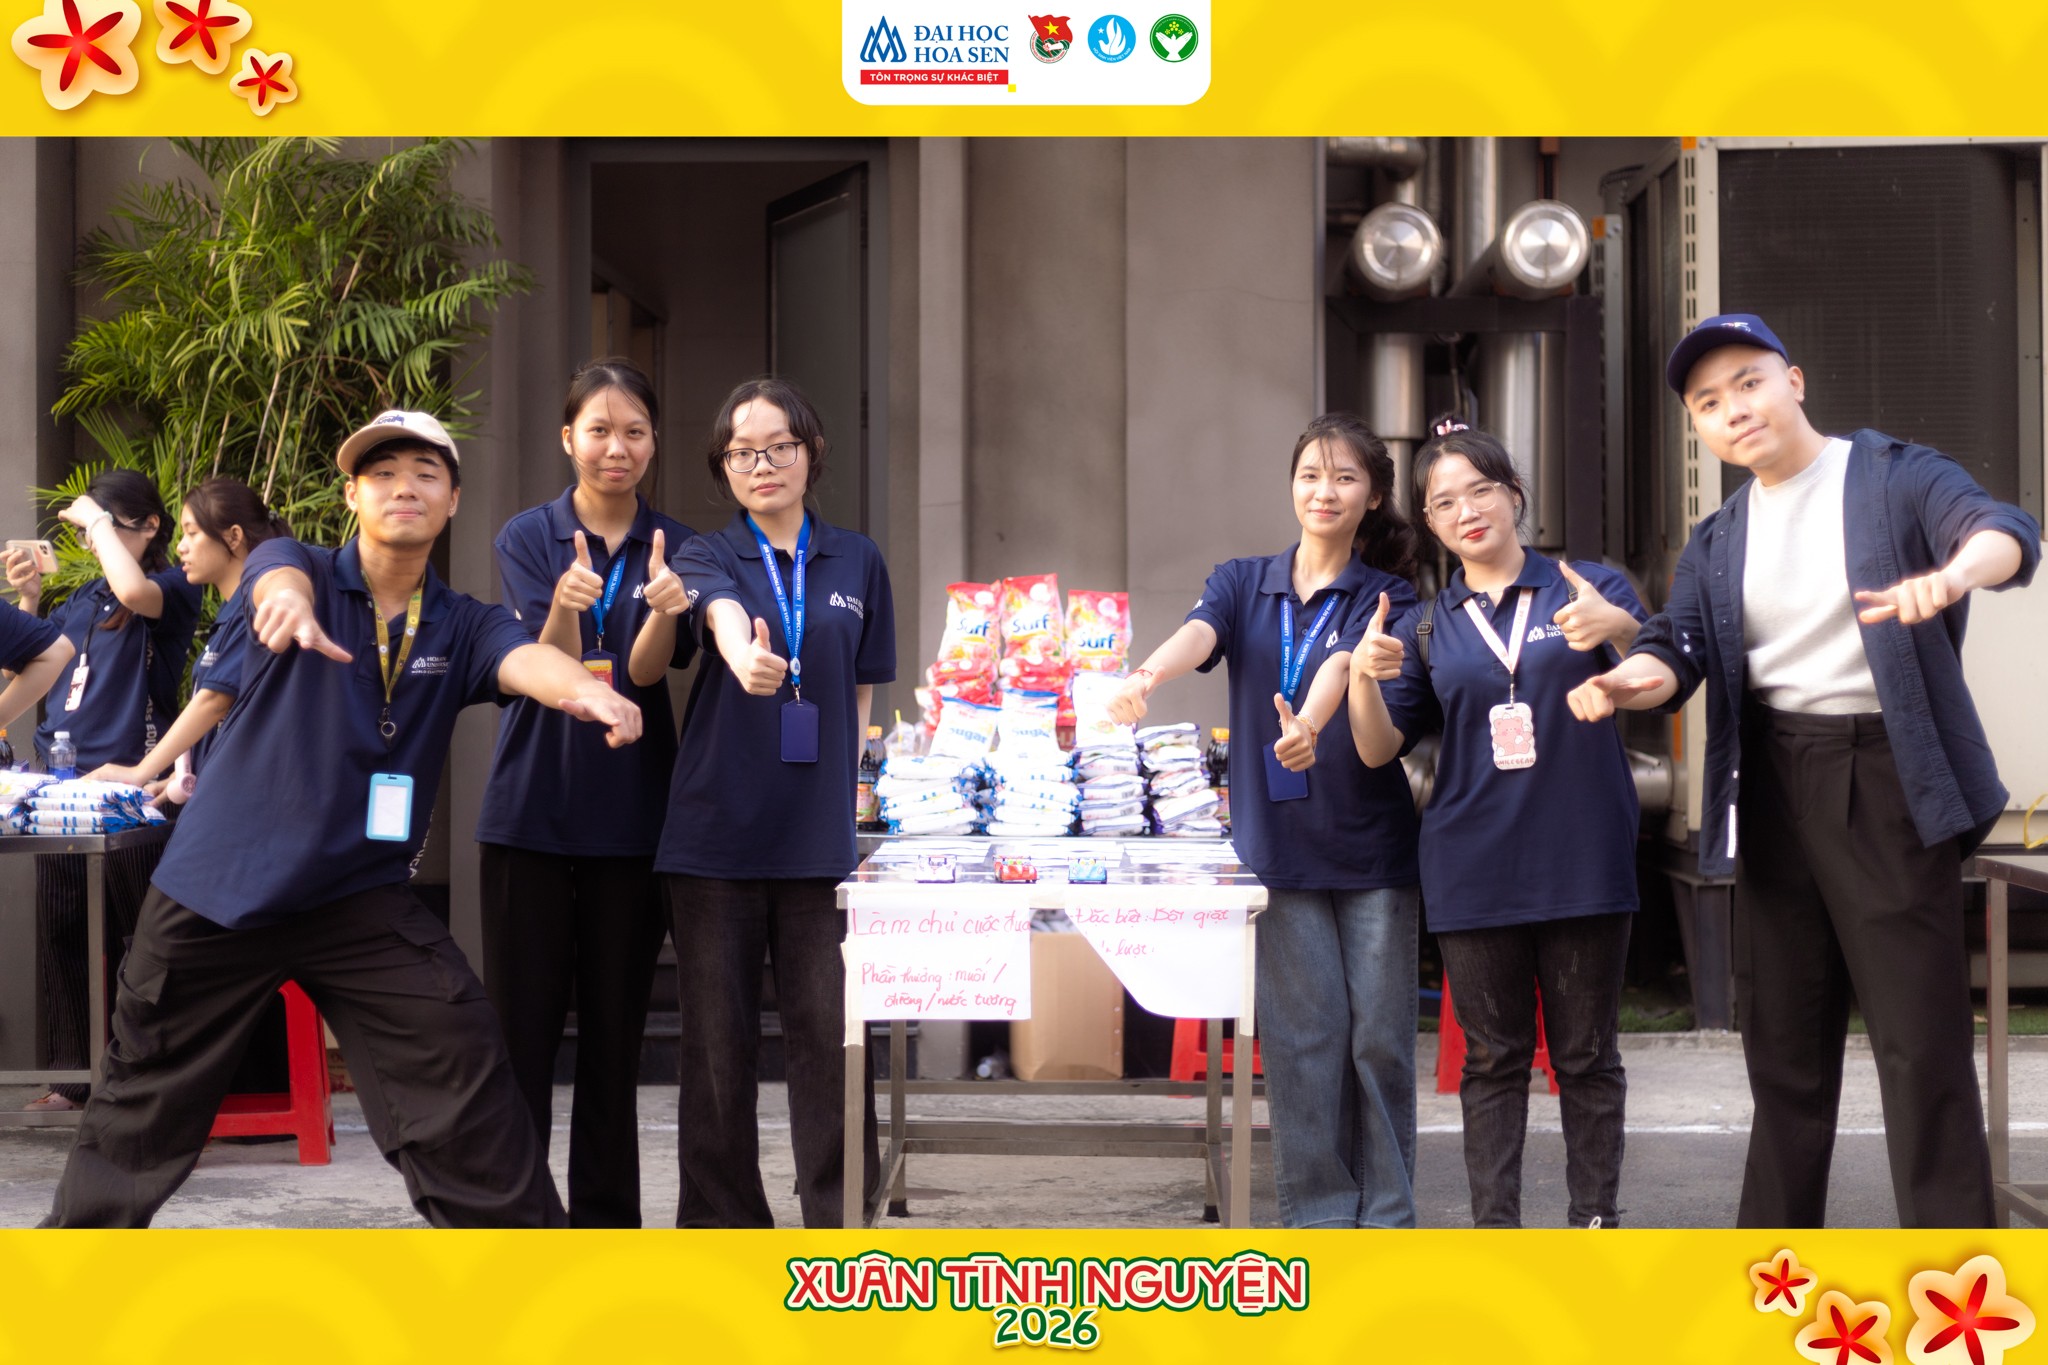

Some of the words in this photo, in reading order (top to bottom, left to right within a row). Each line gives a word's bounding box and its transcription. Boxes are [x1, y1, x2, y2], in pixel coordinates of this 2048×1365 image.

[956, 618, 990, 636] Surf
[1012, 614, 1050, 633] Surf
[1078, 631, 1116, 648] Surf
[918, 910, 958, 934] chủ
